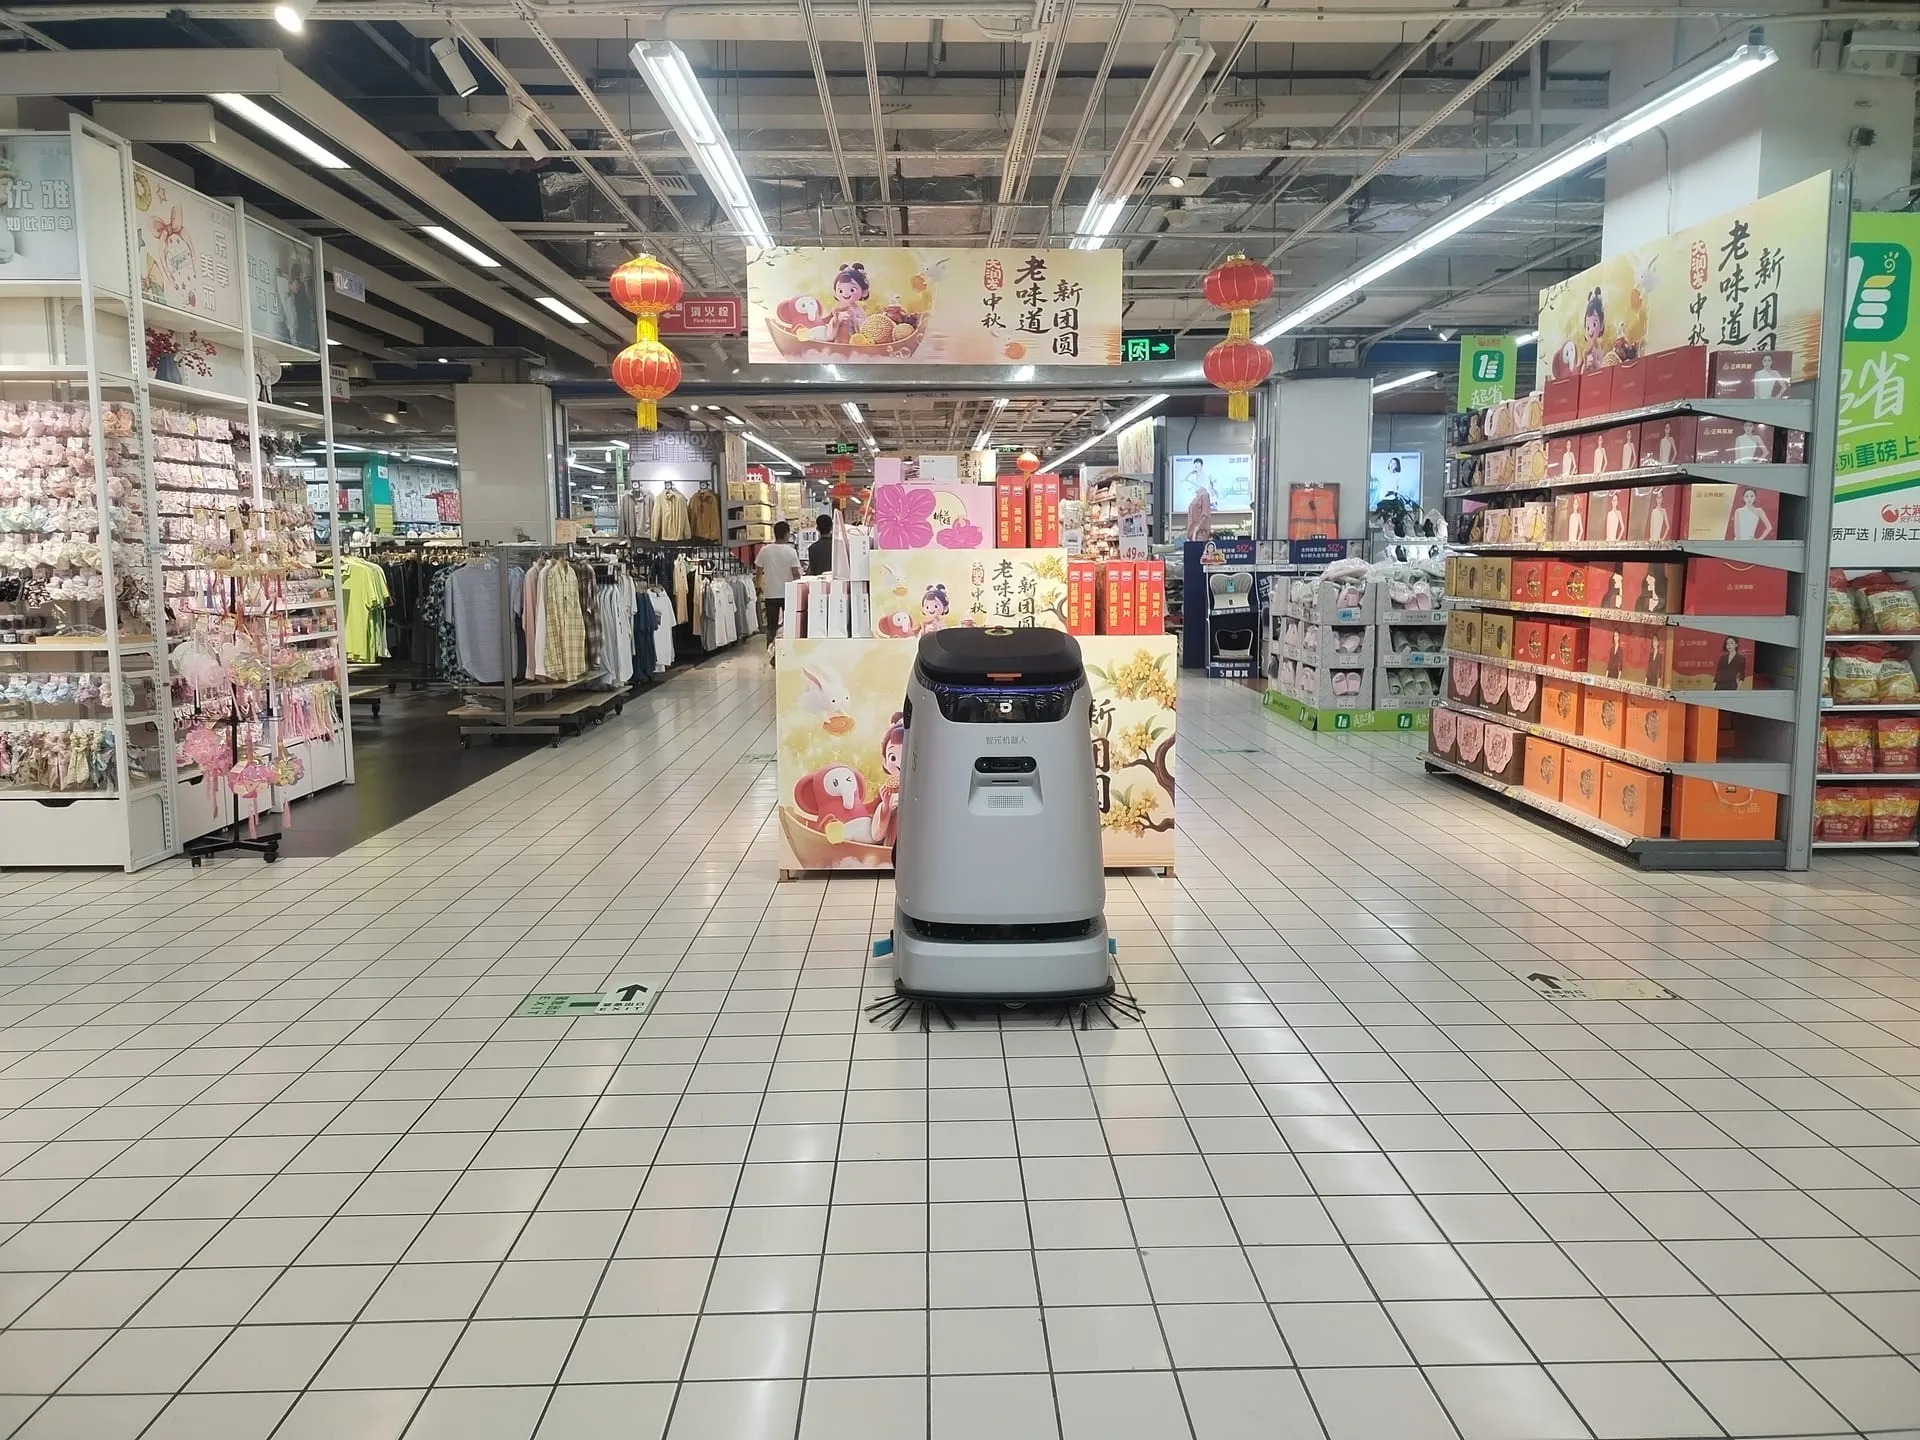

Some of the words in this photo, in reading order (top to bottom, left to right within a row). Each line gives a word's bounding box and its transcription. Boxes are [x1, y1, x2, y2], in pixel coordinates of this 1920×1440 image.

[6, 180, 72, 209] 优雅
[6, 215, 73, 232] 如此简单
[1014, 255, 1050, 334] 老味道
[1717, 219, 1752, 346] 老味道
[981, 292, 1006, 329] 中秋
[1052, 279, 1083, 358] 新团圆
[1688, 292, 1709, 346] 中秋
[1836, 435, 1920, 471] 列重磅上
[970, 587, 988, 615] 中秋
[991, 560, 1016, 618] 老味道
[985, 735, 1028, 745] 智元机器人
